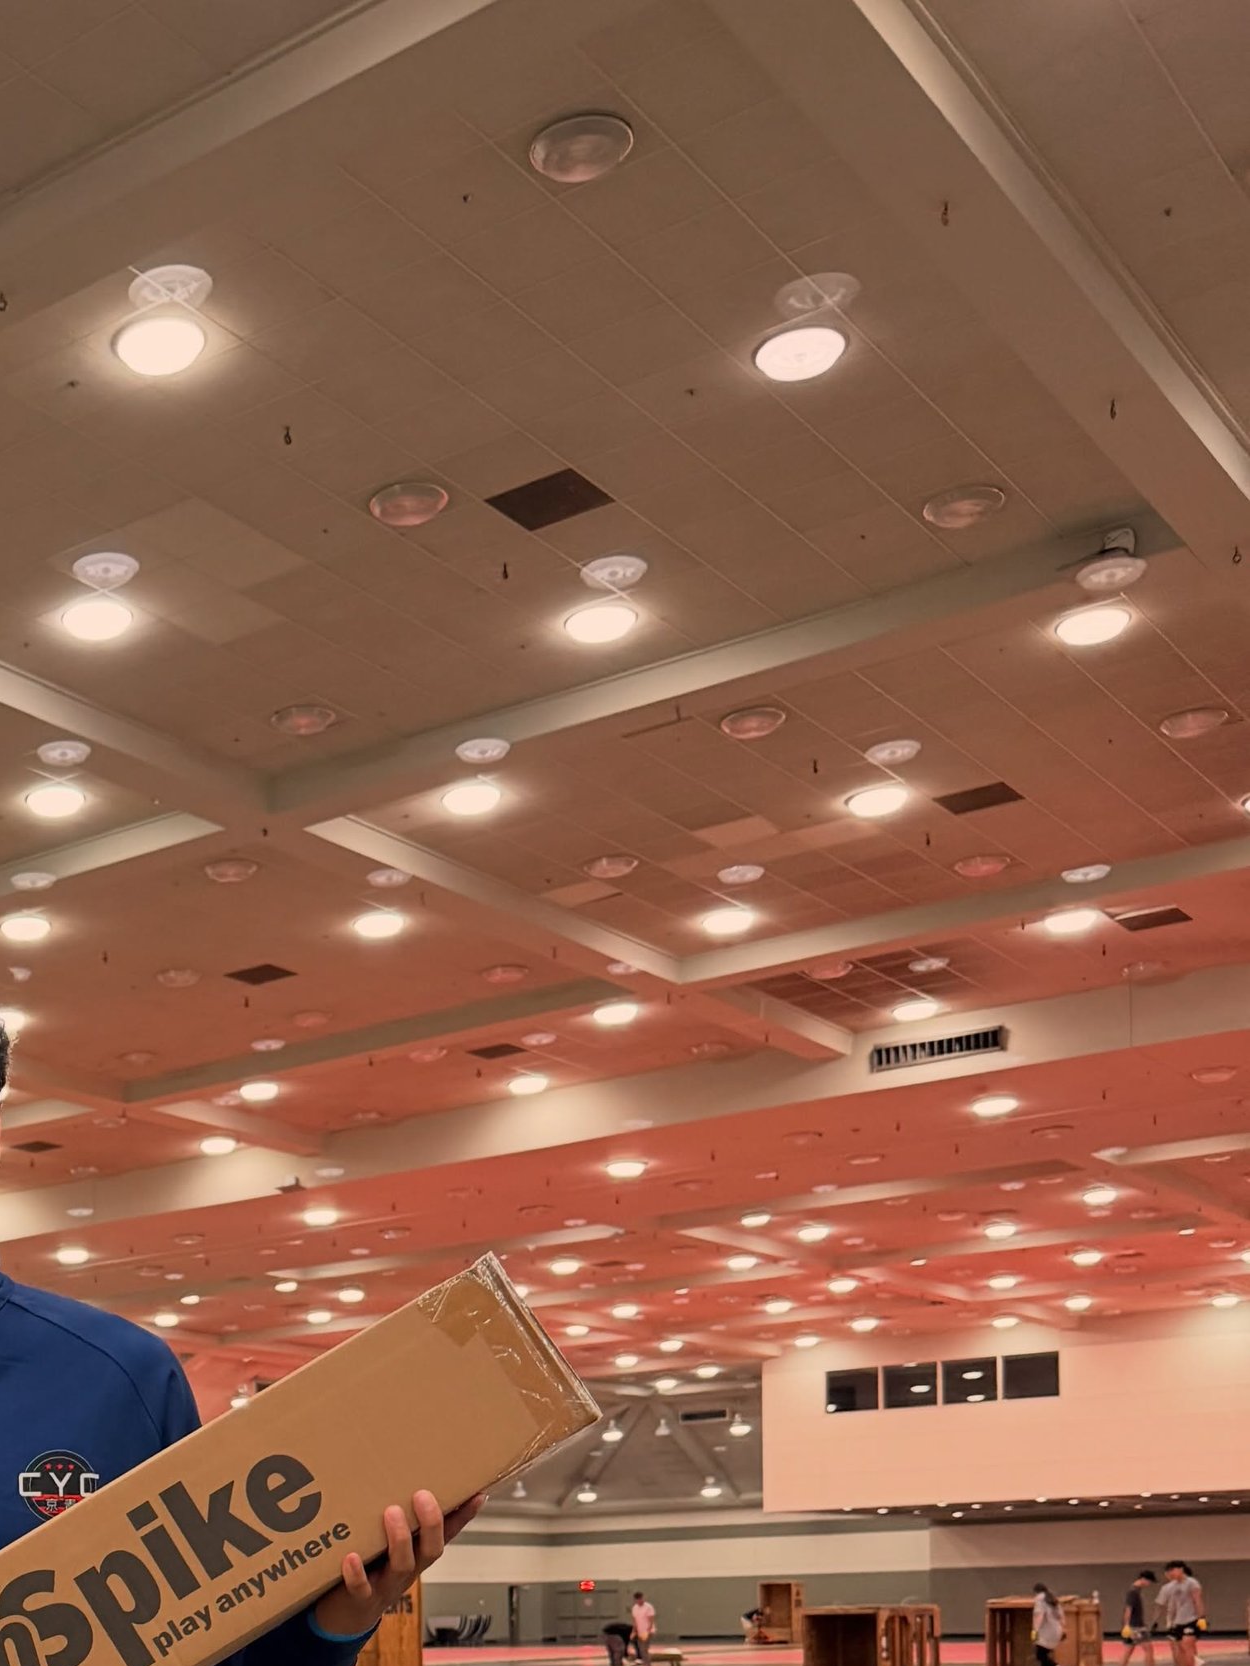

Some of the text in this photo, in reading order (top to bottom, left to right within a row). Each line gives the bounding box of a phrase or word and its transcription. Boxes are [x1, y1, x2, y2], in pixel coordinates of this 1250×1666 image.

[19, 1472, 100, 1498] CYC
[152, 1522, 351, 1658] play anywhere
